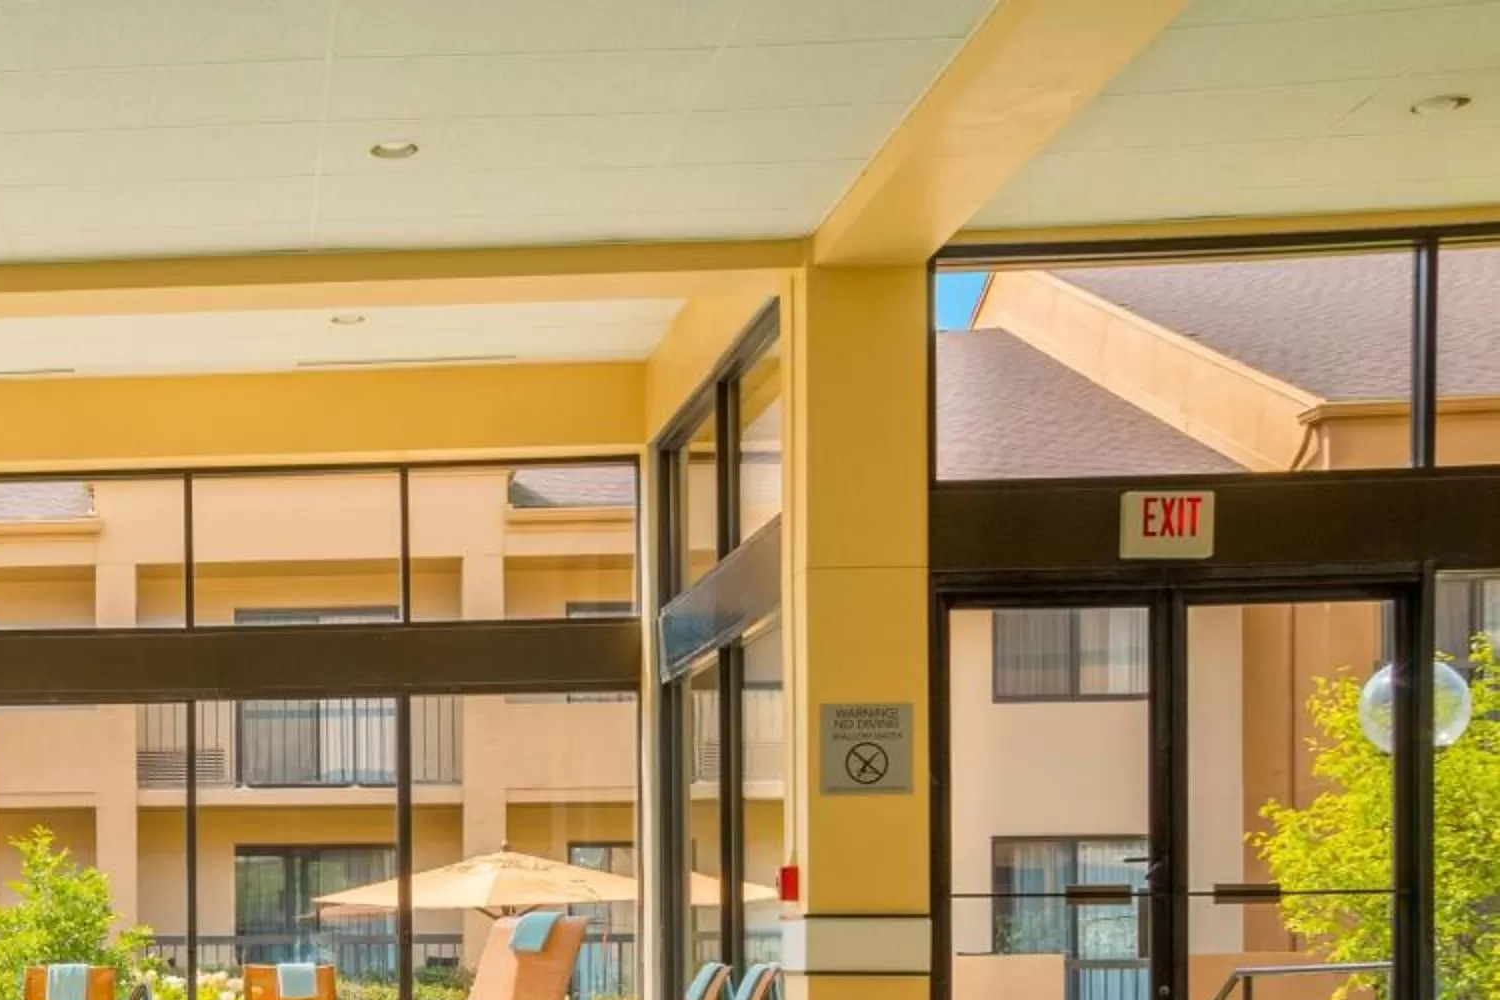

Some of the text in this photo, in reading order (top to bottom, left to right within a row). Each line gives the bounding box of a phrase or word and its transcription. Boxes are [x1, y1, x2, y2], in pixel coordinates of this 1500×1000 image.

[1143, 497, 1202, 537] EXIT
[835, 707, 900, 720] WARNING
[833, 719, 900, 730] NO DIVING
